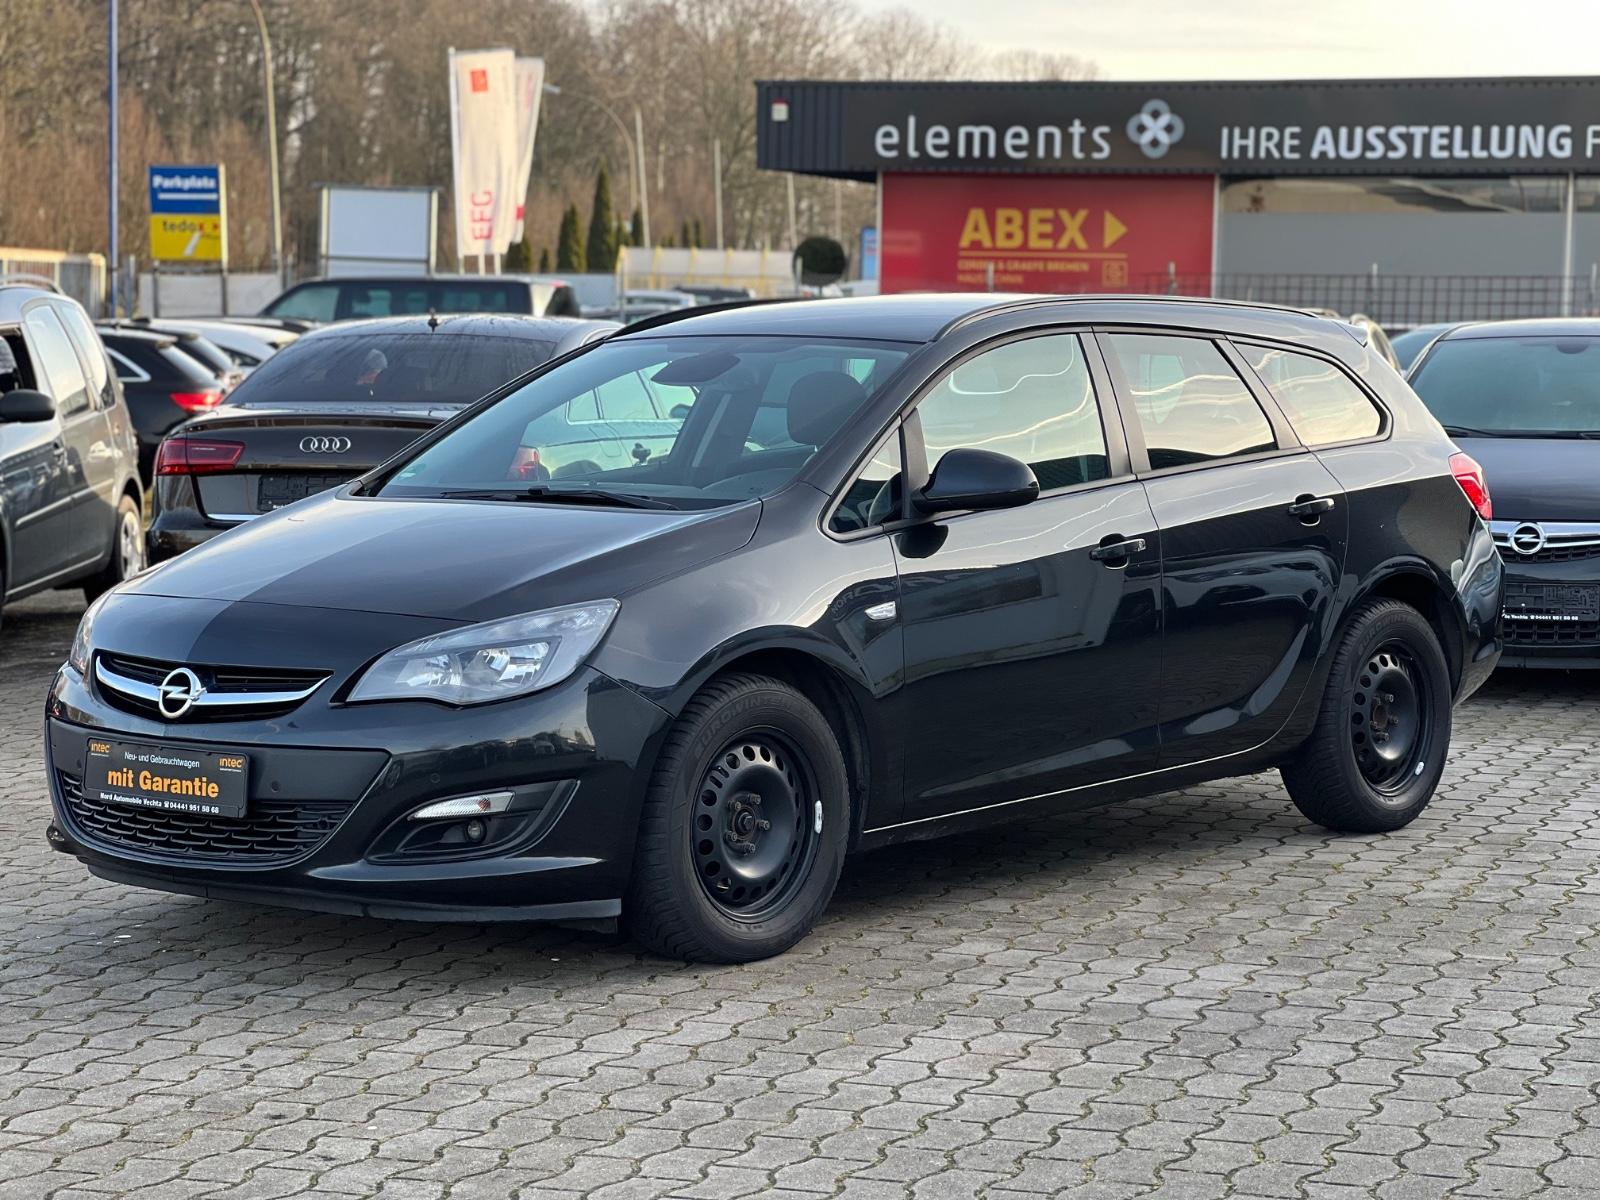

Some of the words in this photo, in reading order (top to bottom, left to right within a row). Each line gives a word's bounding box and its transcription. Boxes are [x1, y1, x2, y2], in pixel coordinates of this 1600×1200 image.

[874, 114, 1112, 160] elements
[1219, 126, 1302, 160] IHRE
[1310, 125, 1573, 160] AUSSTELLUNG
[959, 207, 1090, 250] ABEX
[91, 742, 110, 753] intec
[124, 751, 137, 760] Neu-
[138, 753, 150, 762] und
[150, 754, 200, 769] Gebrauchtwagen
[219, 757, 243, 768] intec
[107, 768, 134, 788] mit
[138, 770, 220, 798] Garantie
[100, 792, 113, 801] Nord
[113, 793, 142, 805] Automobile
[143, 798, 162, 808] Vechta
